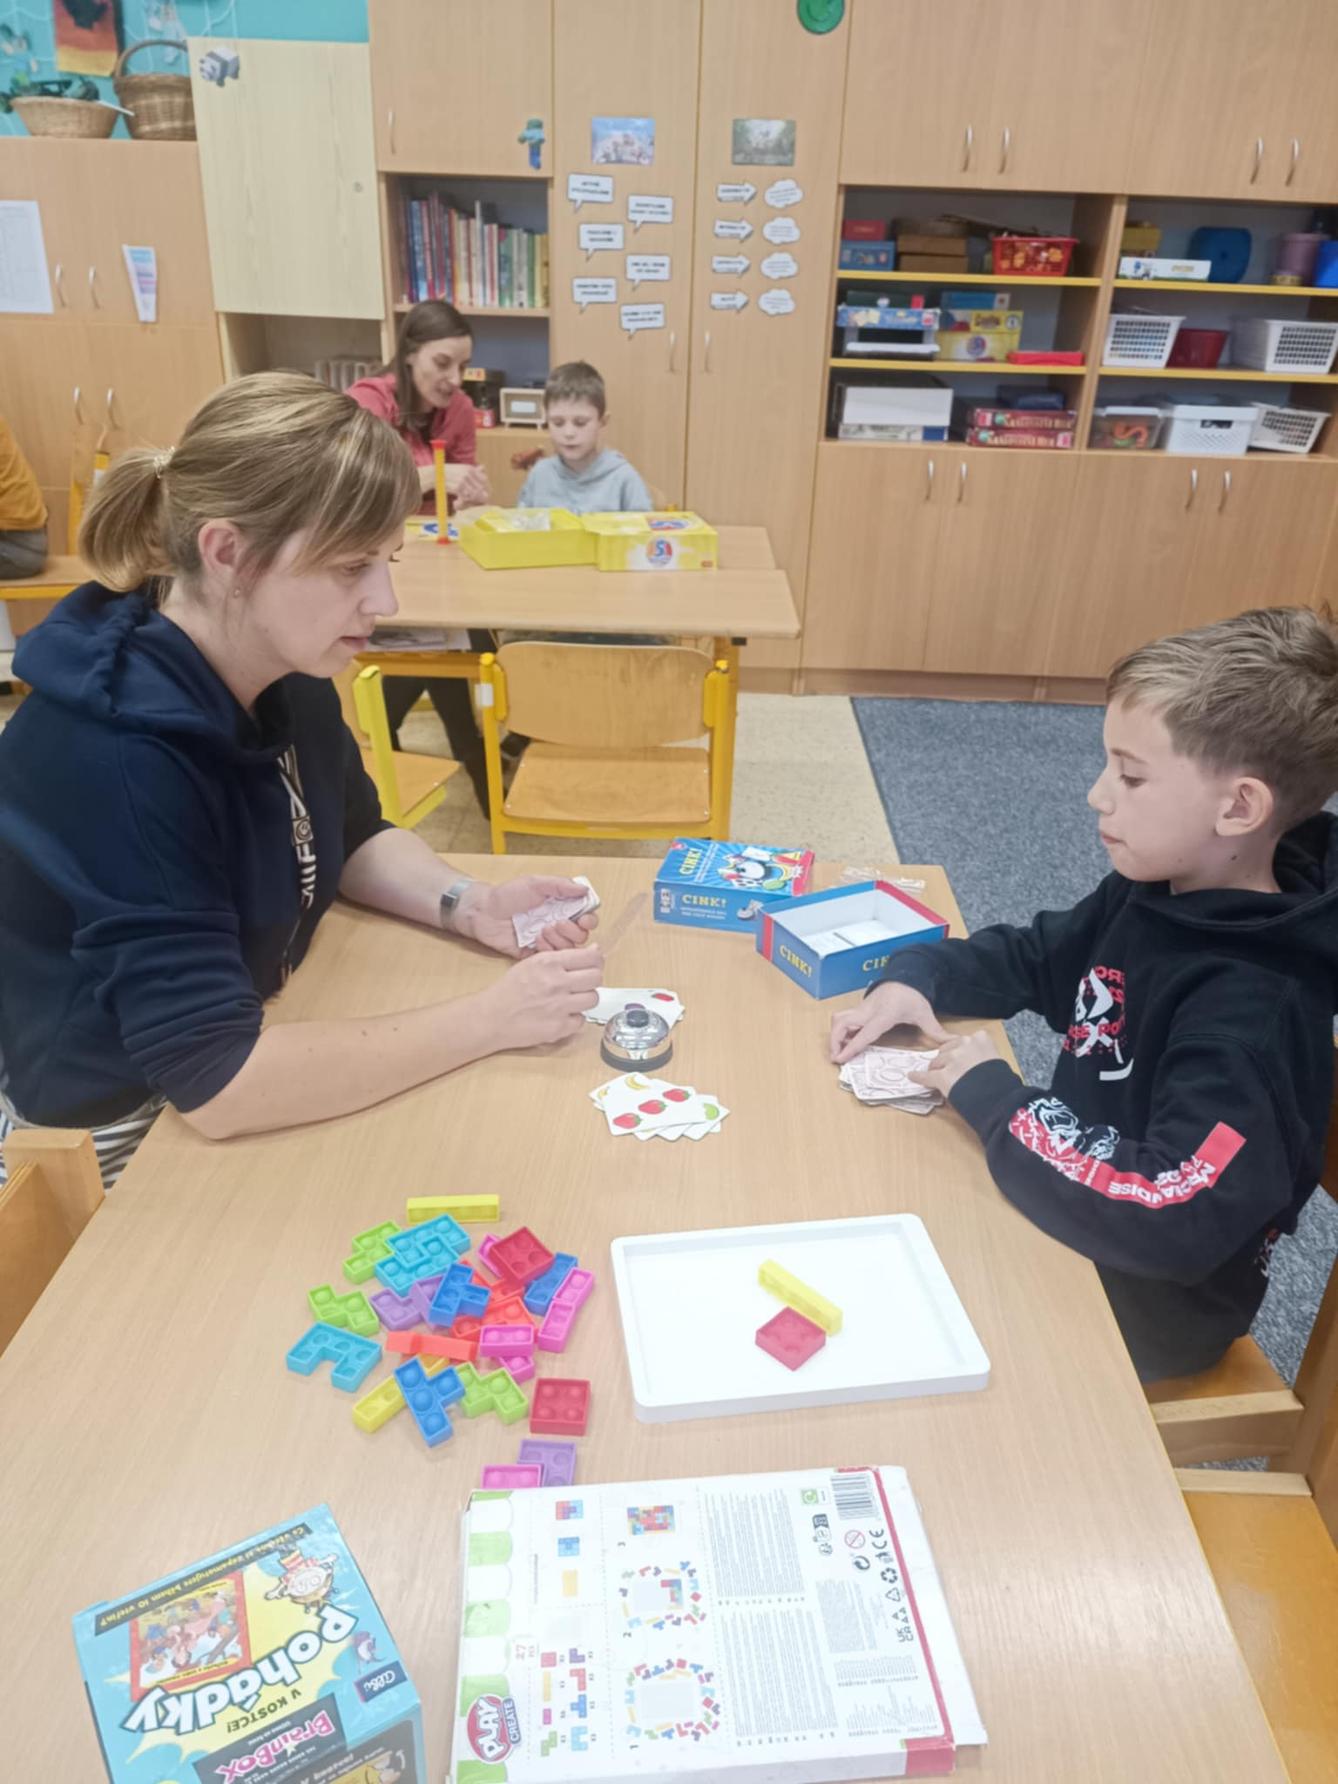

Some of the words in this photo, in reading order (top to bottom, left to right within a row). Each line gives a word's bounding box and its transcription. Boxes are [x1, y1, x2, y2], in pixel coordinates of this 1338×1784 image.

[679, 848, 702, 875] CINK!
[682, 894, 727, 908] CINK!
[779, 944, 812, 978] CINK!
[138, 1599, 150, 1608] 10
[151, 1583, 182, 1601] během
[101, 1605, 135, 1626] vteřin?
[120, 1603, 358, 1735] Pohádky
[227, 1698, 288, 1734] KOSTCE!
[477, 1697, 505, 1759] PLAY
[503, 1698, 520, 1743] CREATE
[214, 1710, 336, 1784] BrainBox
